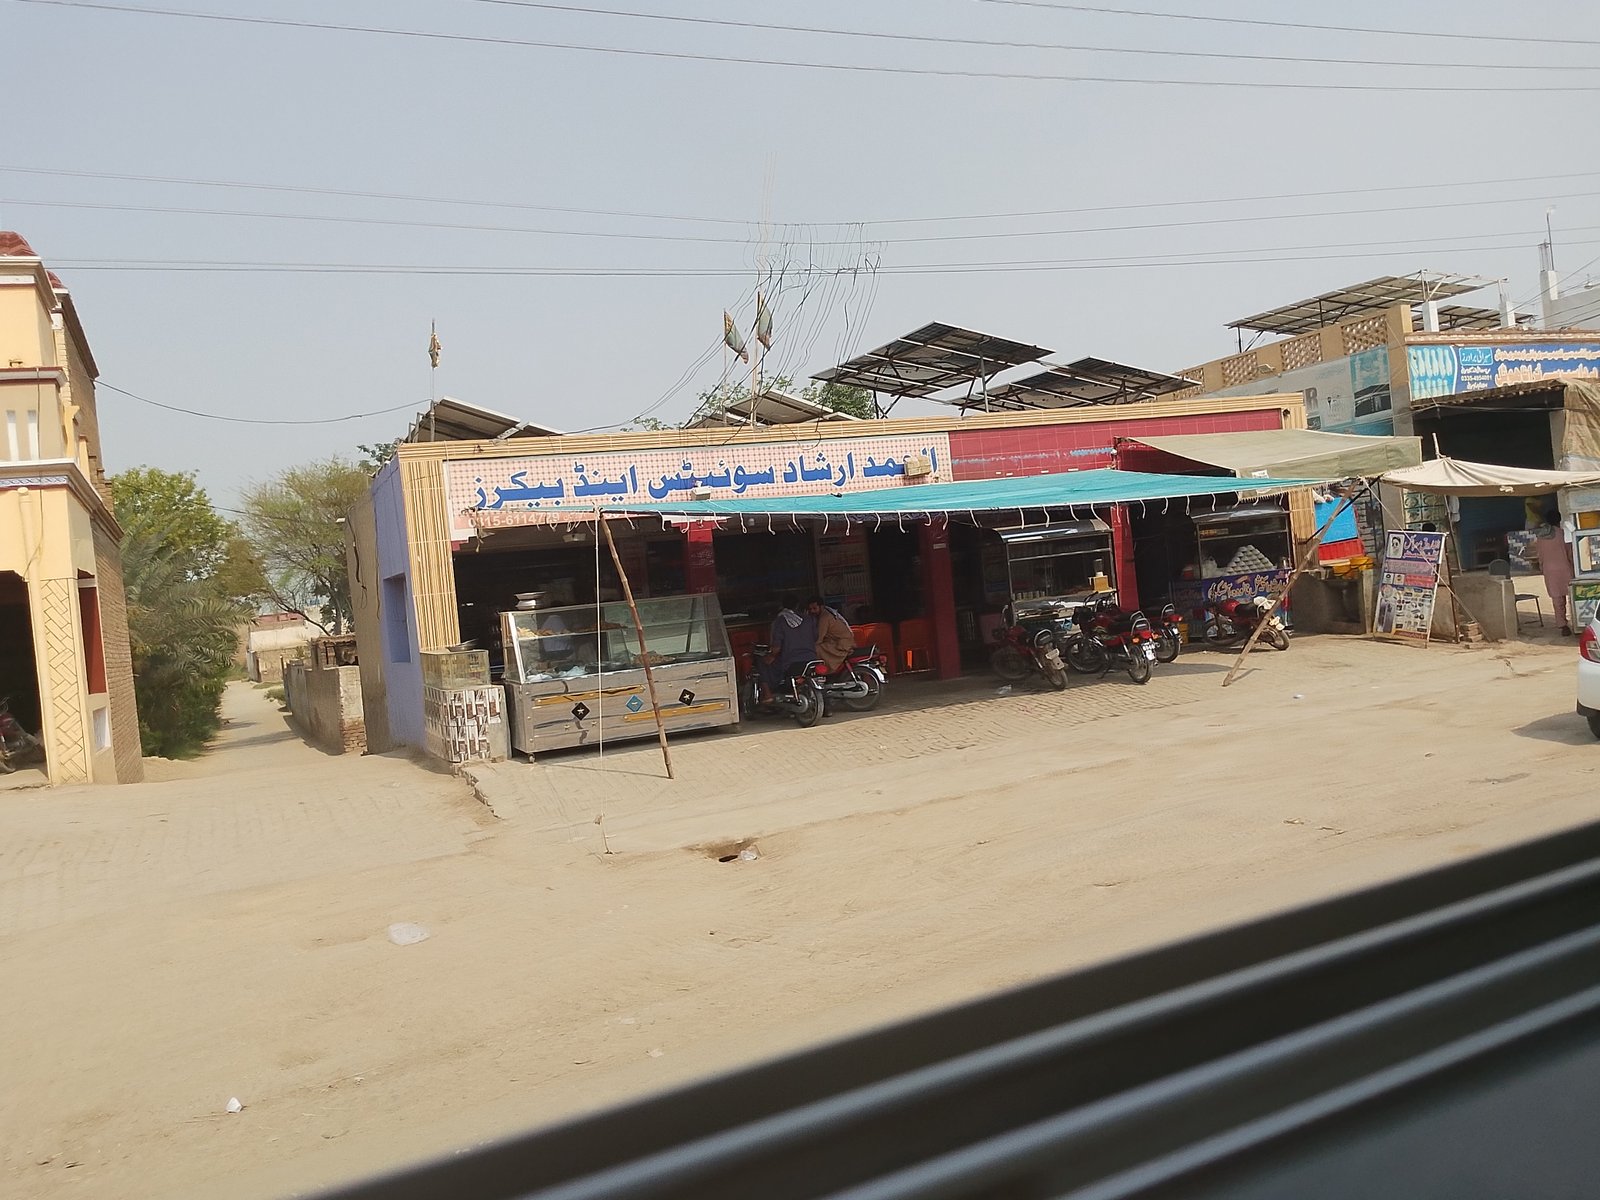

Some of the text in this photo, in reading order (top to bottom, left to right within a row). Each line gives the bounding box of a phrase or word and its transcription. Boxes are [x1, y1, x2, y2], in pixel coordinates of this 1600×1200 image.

[783, 450, 855, 487] ارشاد
[862, 446, 938, 478] امد
[474, 470, 565, 509] بیکرز
[573, 461, 638, 502] اینڈ
